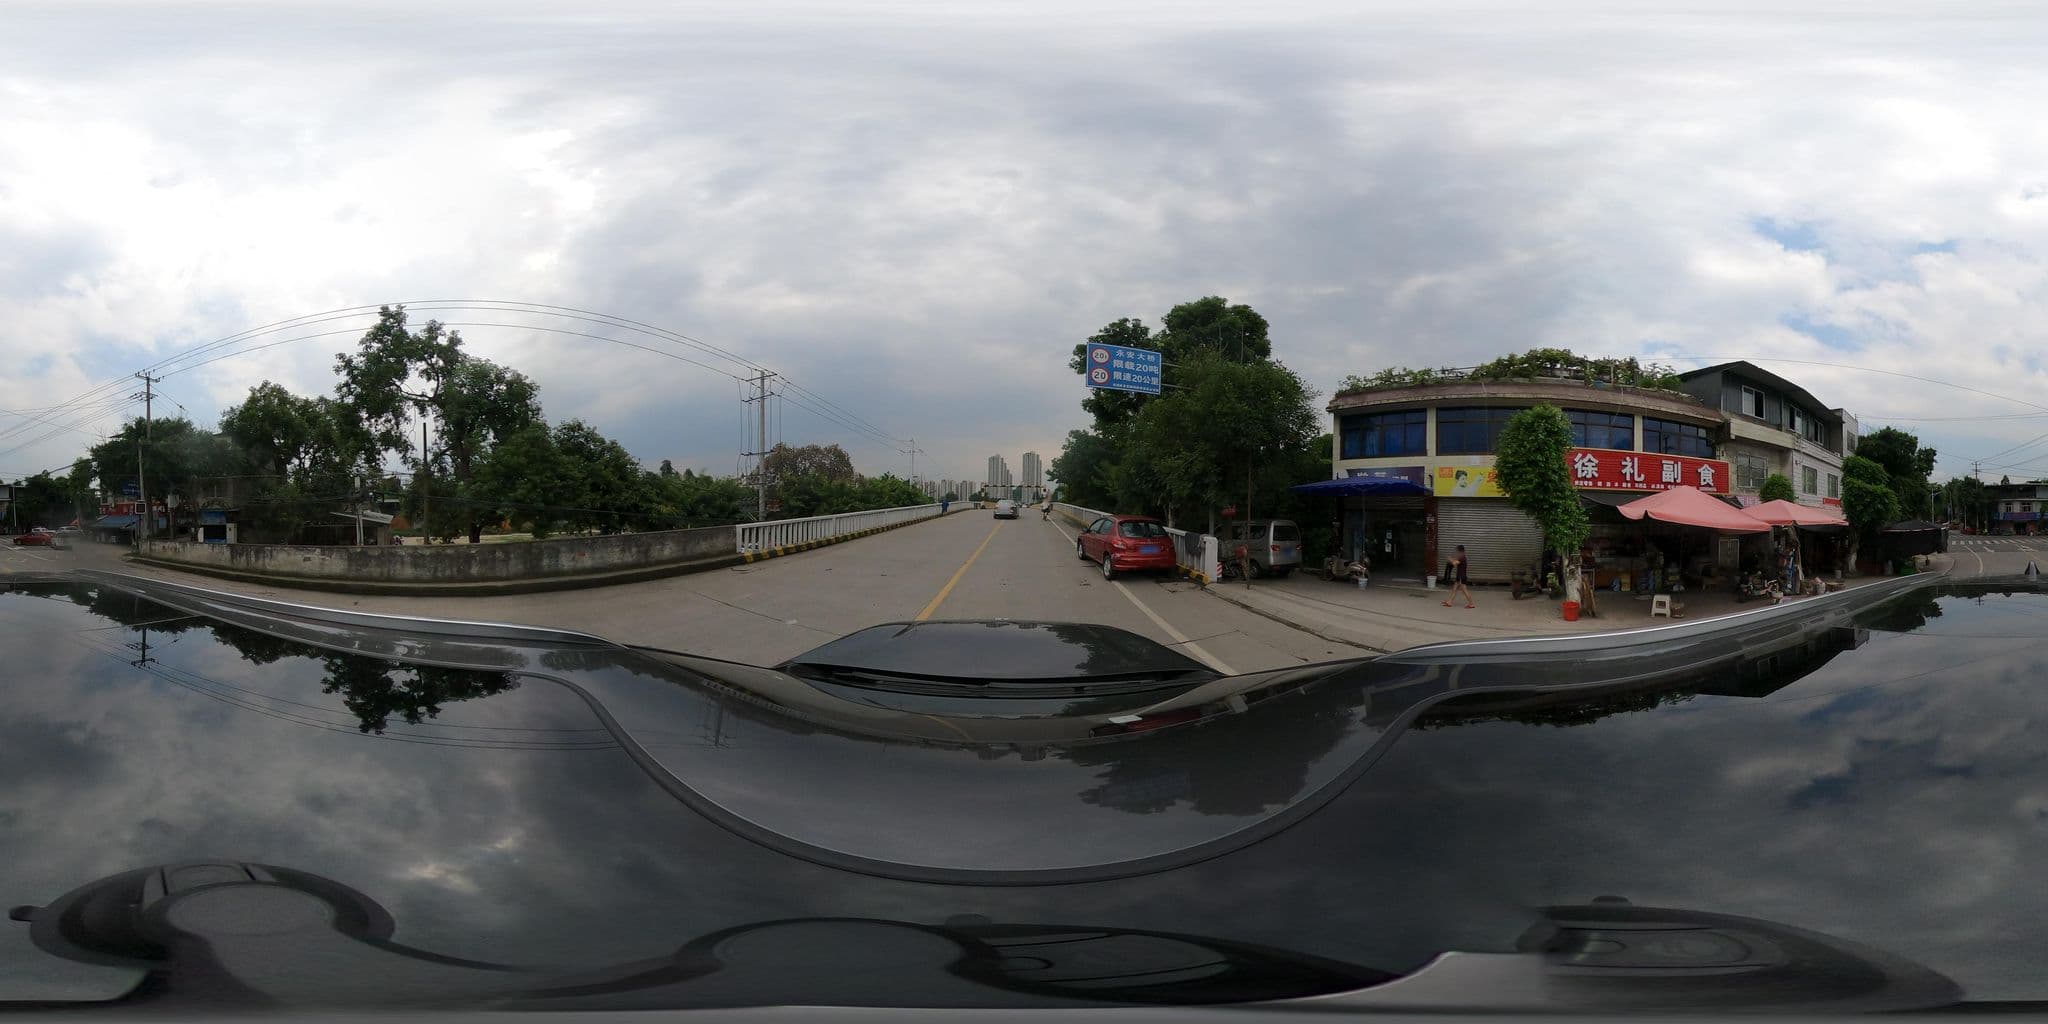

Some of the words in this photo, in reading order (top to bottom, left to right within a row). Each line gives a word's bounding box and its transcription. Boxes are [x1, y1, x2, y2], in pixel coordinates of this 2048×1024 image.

[1094, 371, 1106, 379] 20
[1574, 453, 1716, 487] 徐礼副食
